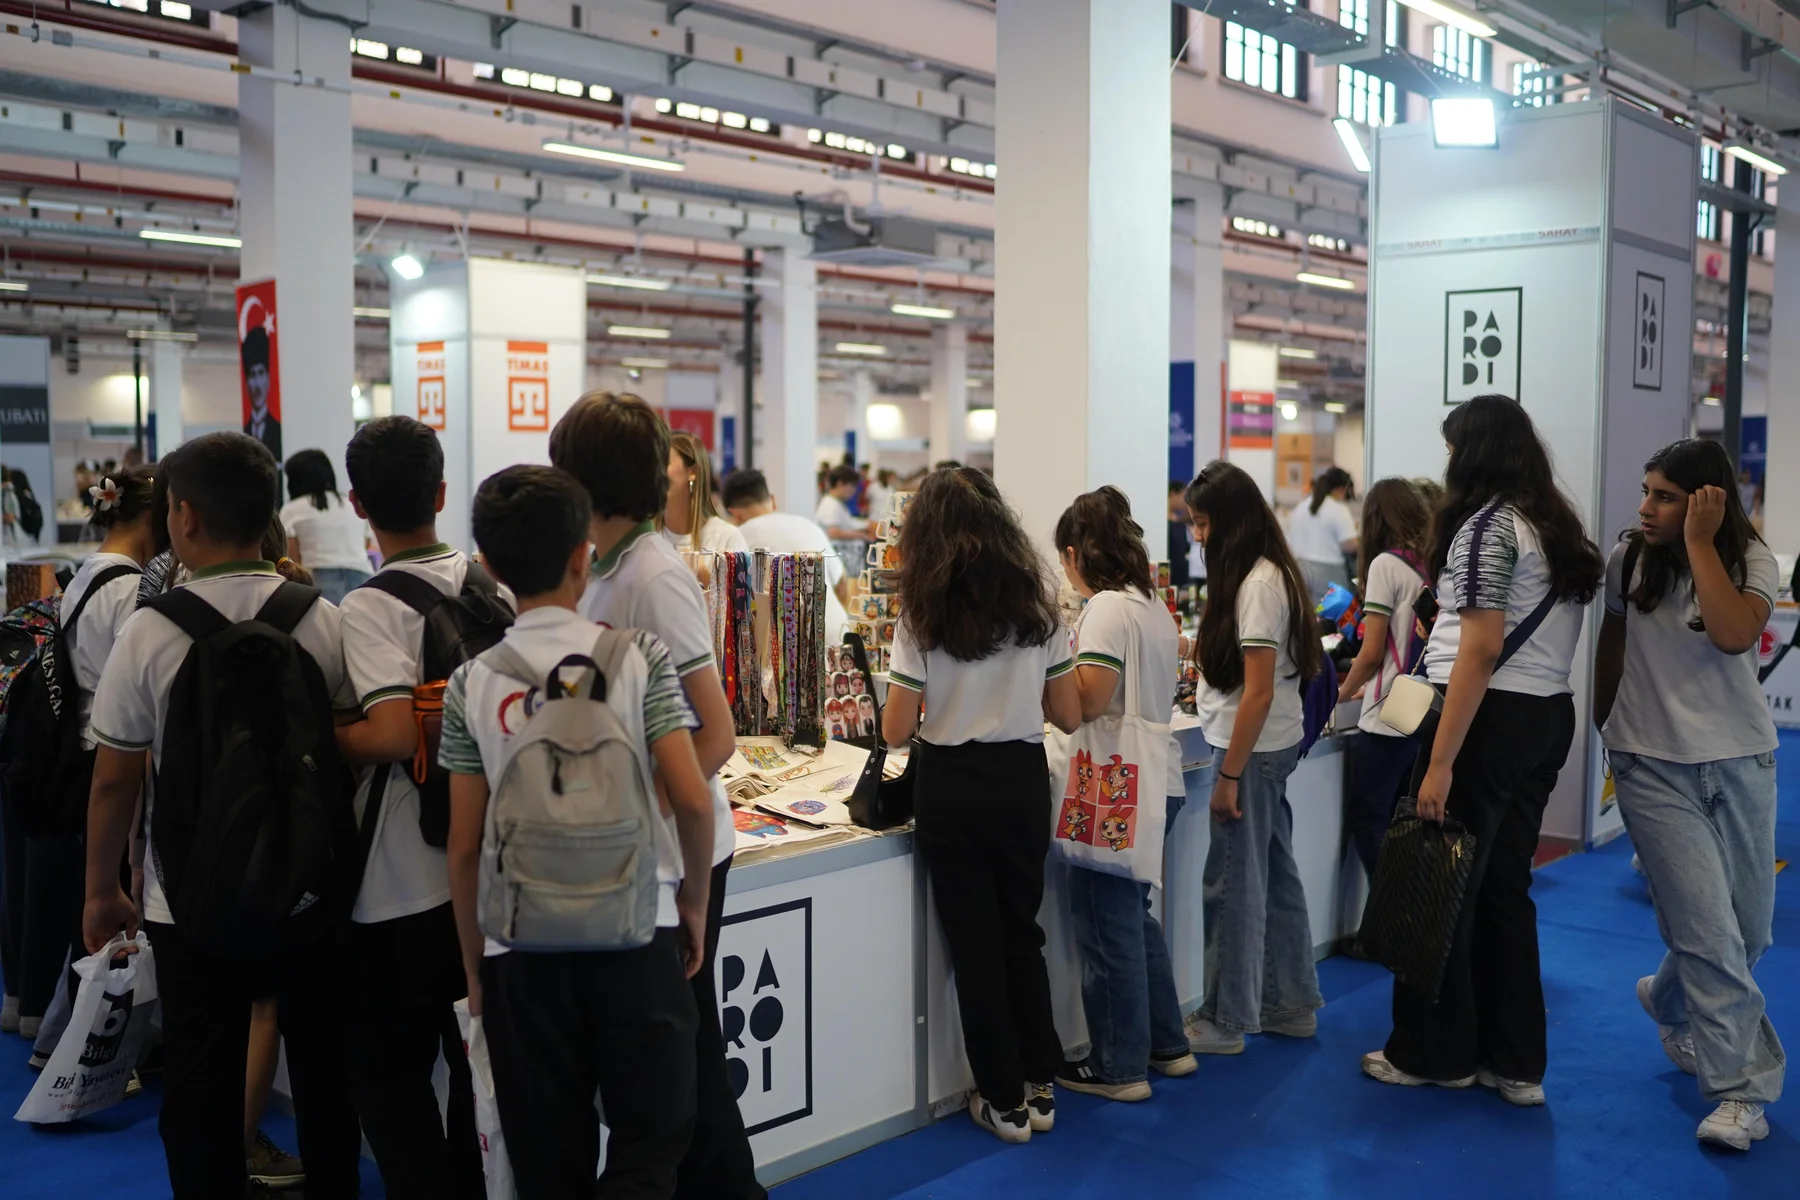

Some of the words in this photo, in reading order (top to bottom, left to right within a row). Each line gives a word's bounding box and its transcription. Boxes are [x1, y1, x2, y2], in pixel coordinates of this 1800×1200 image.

[1463, 309, 1500, 333] PA
[1463, 335, 1502, 359] RO
[1462, 361, 1494, 385] DI
[722, 947, 780, 1003] PA
[722, 996, 783, 1053] RO
